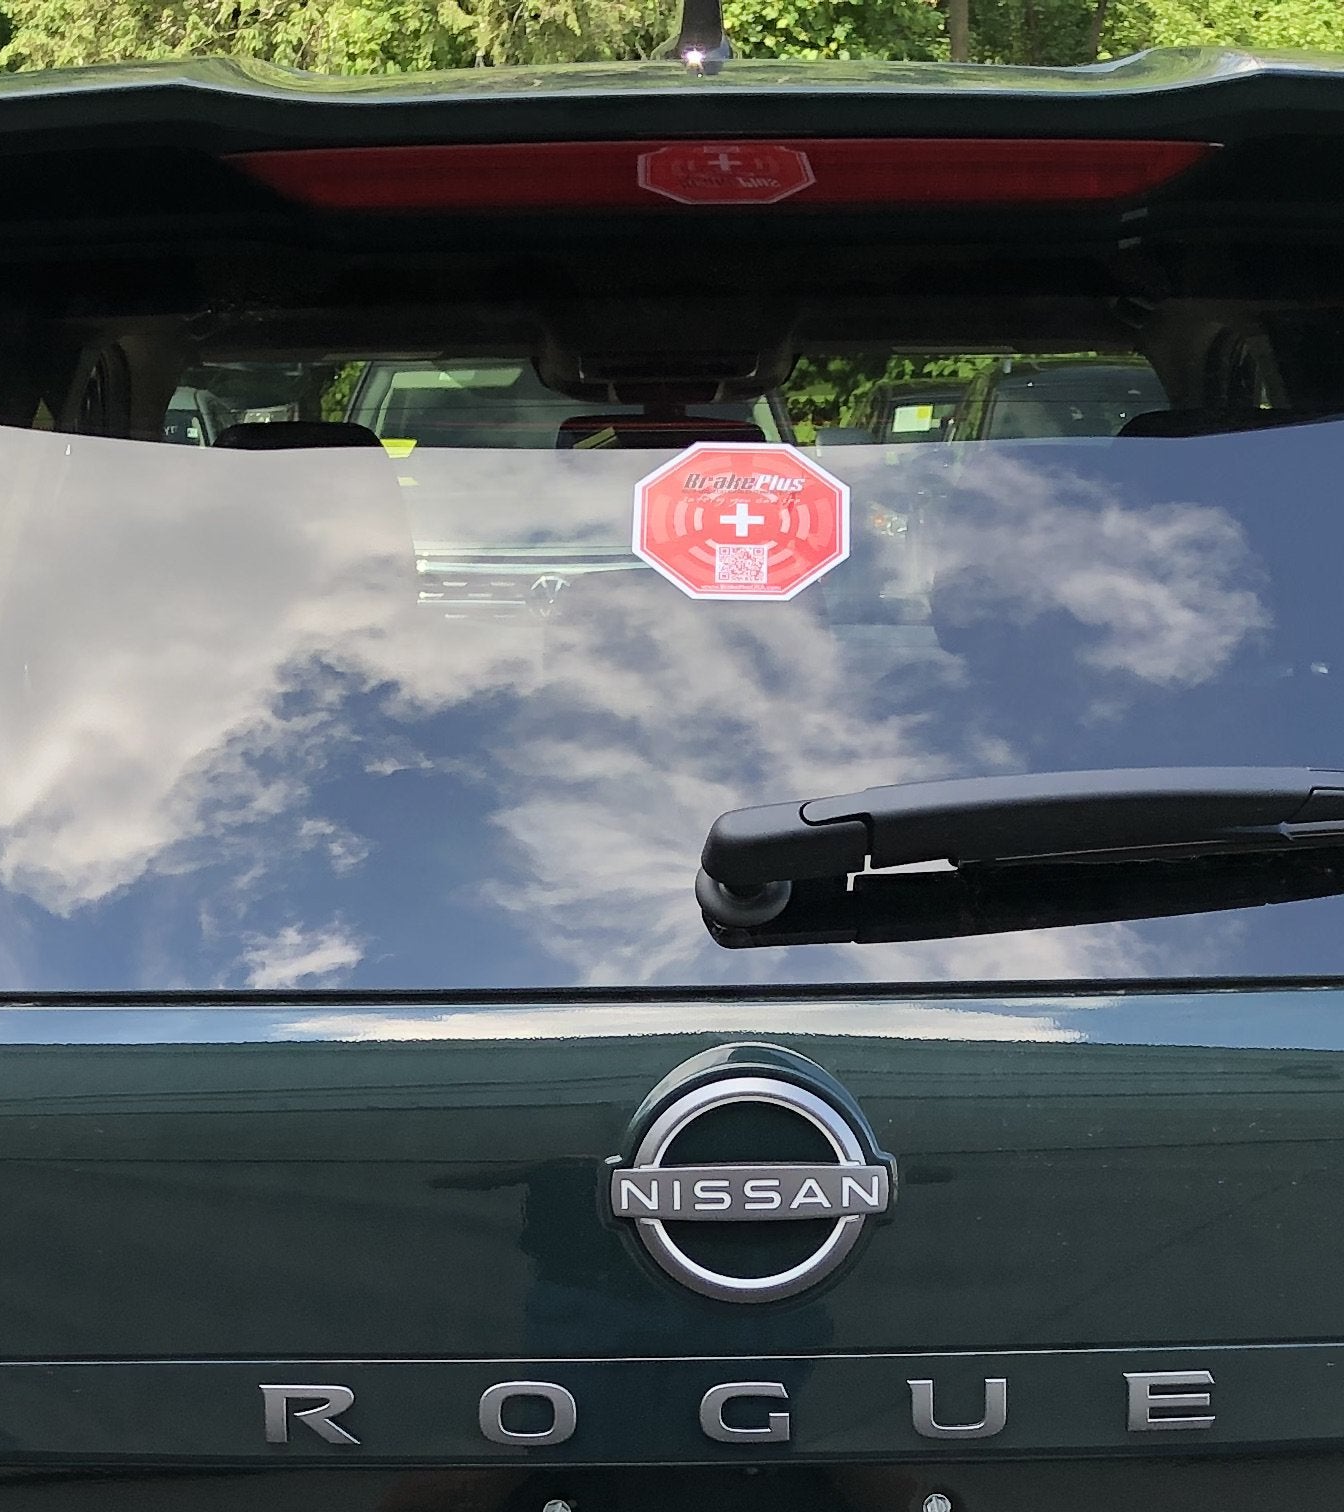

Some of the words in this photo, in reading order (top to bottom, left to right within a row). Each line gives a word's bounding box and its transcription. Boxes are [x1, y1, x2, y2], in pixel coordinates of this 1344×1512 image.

[683, 473, 806, 492] BrakePlus
[620, 1175, 880, 1211] NISSAN
[259, 1370, 1216, 1446] ROGUE
